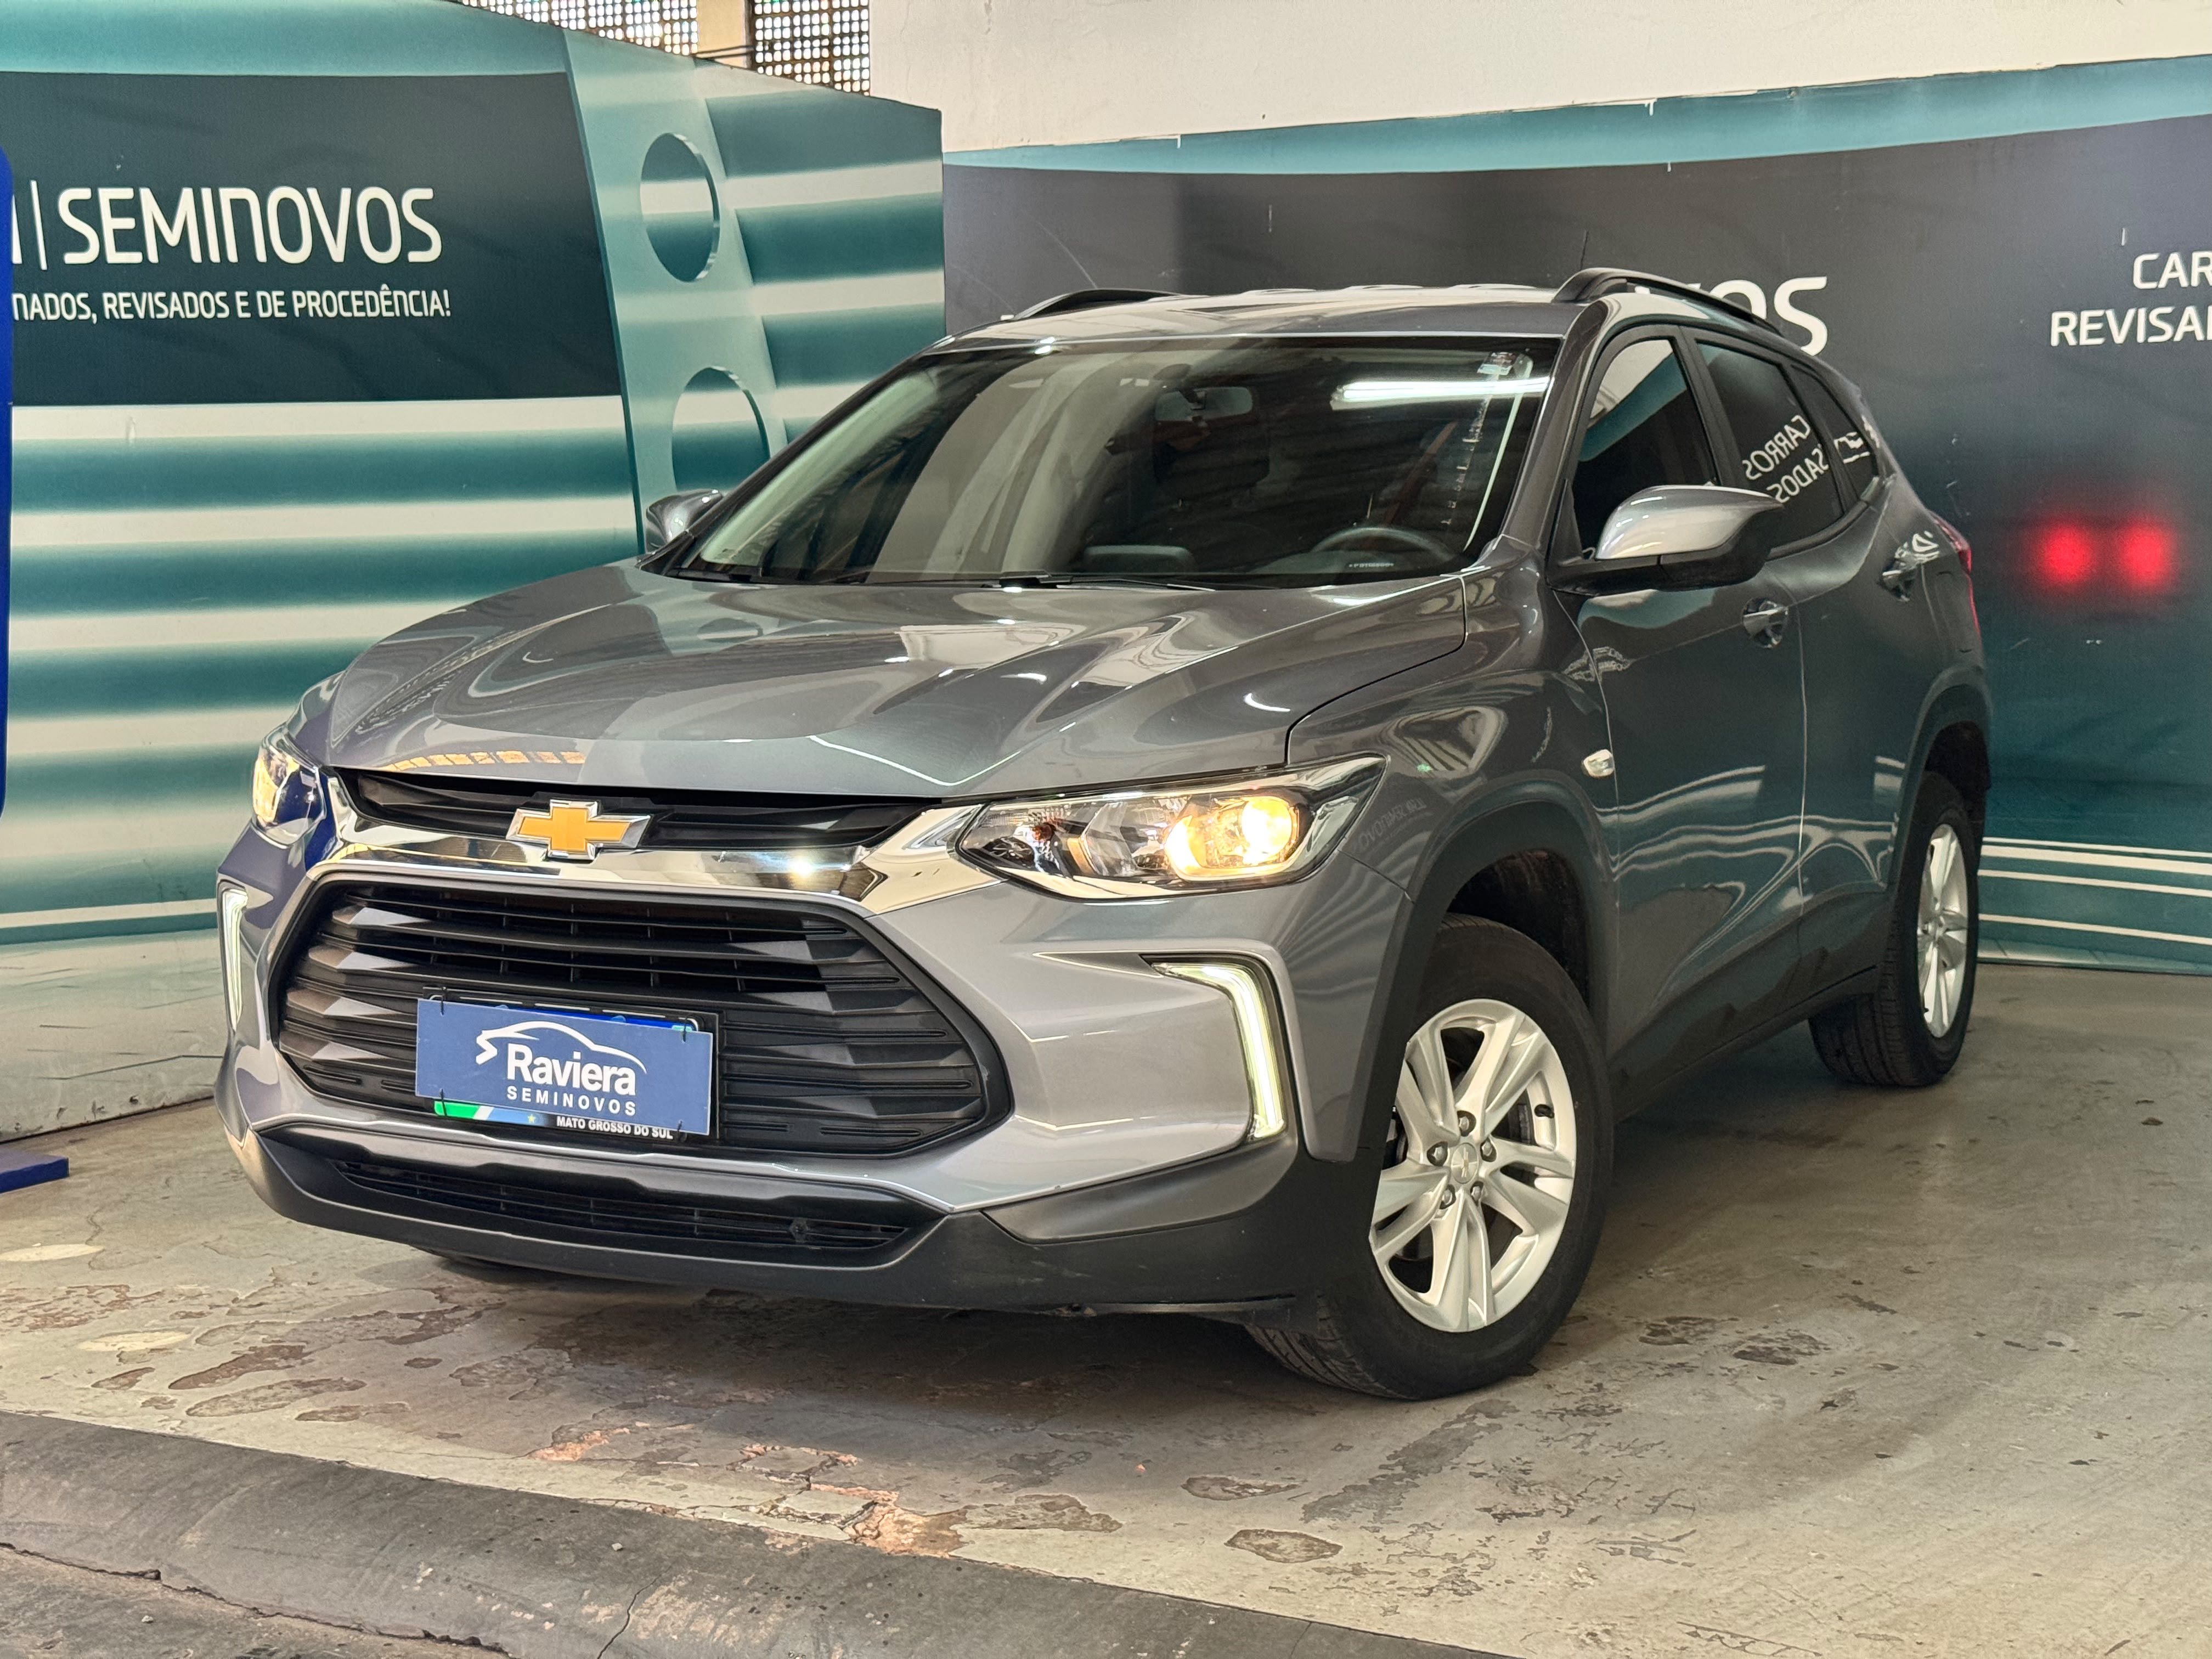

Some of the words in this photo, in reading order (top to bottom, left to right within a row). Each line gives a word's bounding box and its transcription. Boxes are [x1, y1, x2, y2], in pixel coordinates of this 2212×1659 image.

[58, 187, 442, 264] SEMINOVOS
[2133, 251, 2212, 289] CAR
[103, 291, 230, 319] REVISADOS
[235, 291, 251, 318] E
[257, 291, 287, 318] DE
[292, 284, 451, 318] PROCEDÊNCIA!
[2051, 305, 2212, 347] REVISA
[507, 1043, 636, 1096] Raviera
[507, 1086, 636, 1116] SEMINOVOS
[557, 1116, 585, 1129] MATO
[588, 1119, 631, 1135] GROSSO
[634, 1126, 649, 1137] DO
[651, 1128, 673, 1139] SUL
